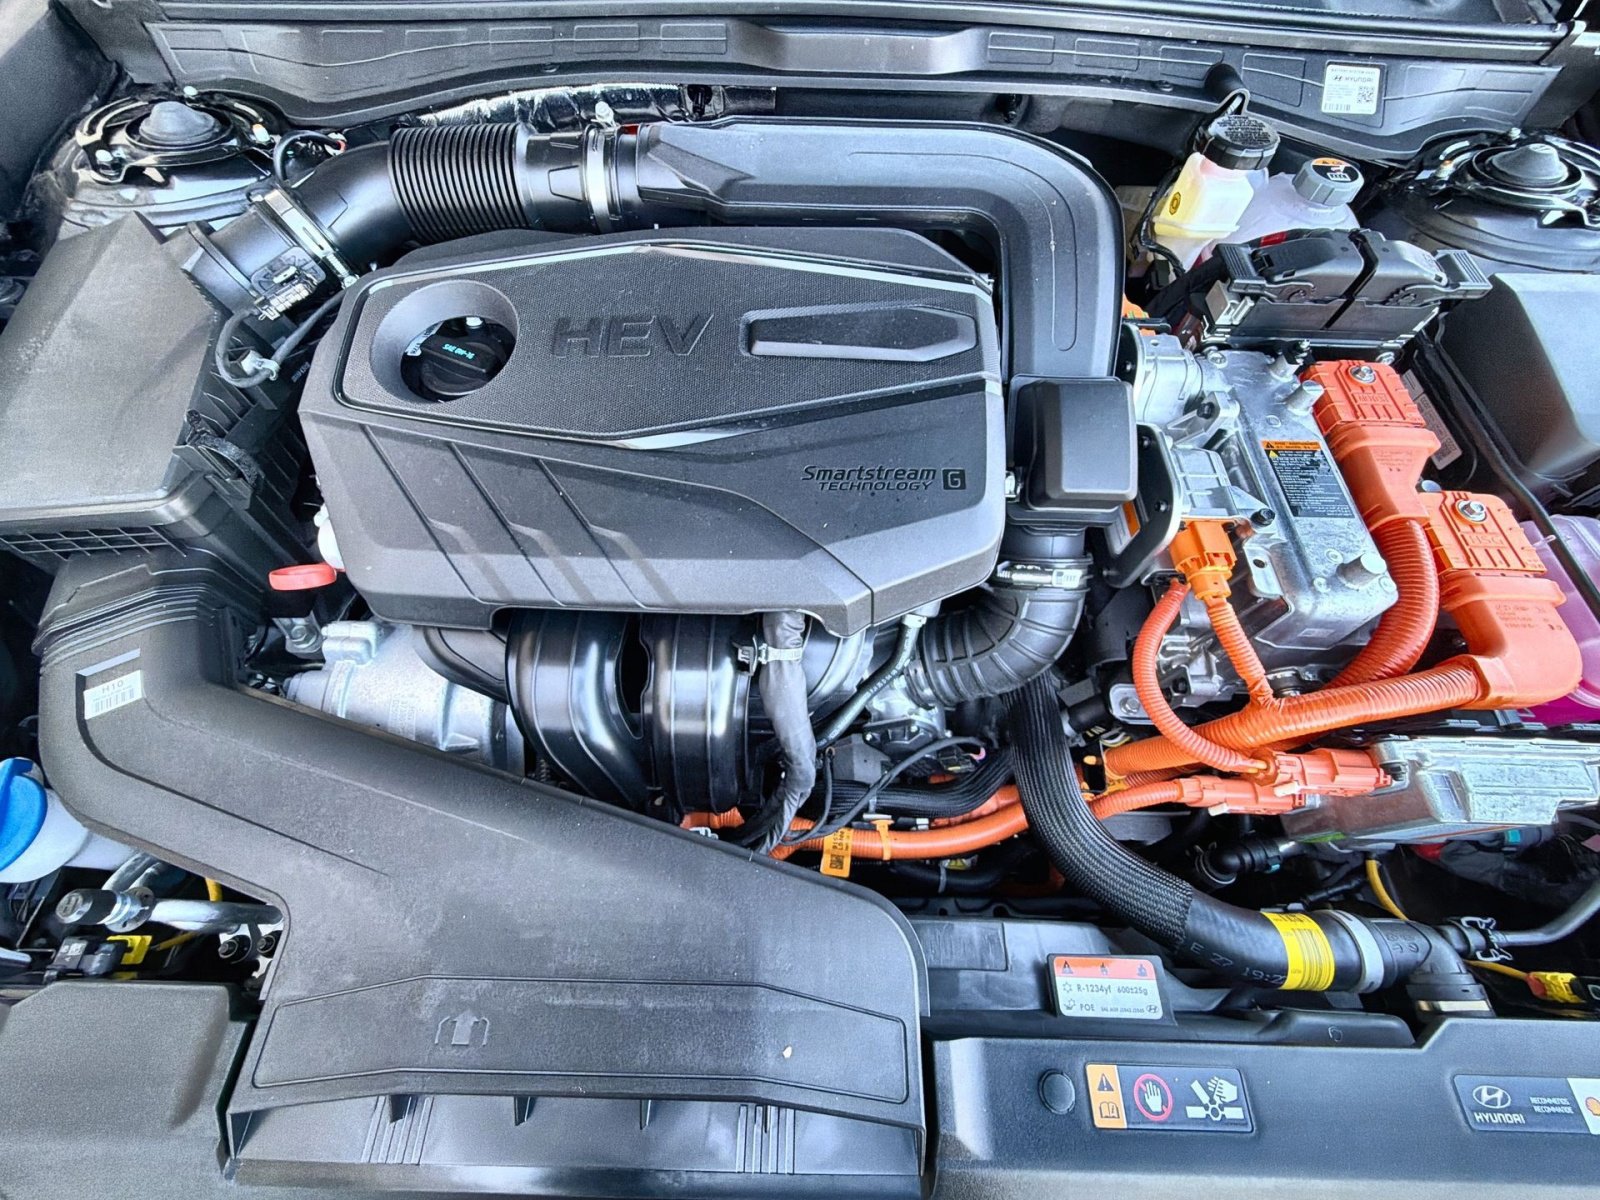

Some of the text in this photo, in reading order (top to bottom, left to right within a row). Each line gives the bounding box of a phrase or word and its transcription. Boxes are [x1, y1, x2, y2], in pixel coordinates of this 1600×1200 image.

[551, 314, 714, 358] HEV
[802, 465, 937, 481] Smartstream
[945, 470, 964, 489] G
[818, 481, 934, 491] TECHNOLOGY
[1077, 983, 1148, 996] R-1234yf 600±25g
[1080, 1003, 1096, 1012] POE
[1473, 1111, 1526, 1124] HYUNDAI
